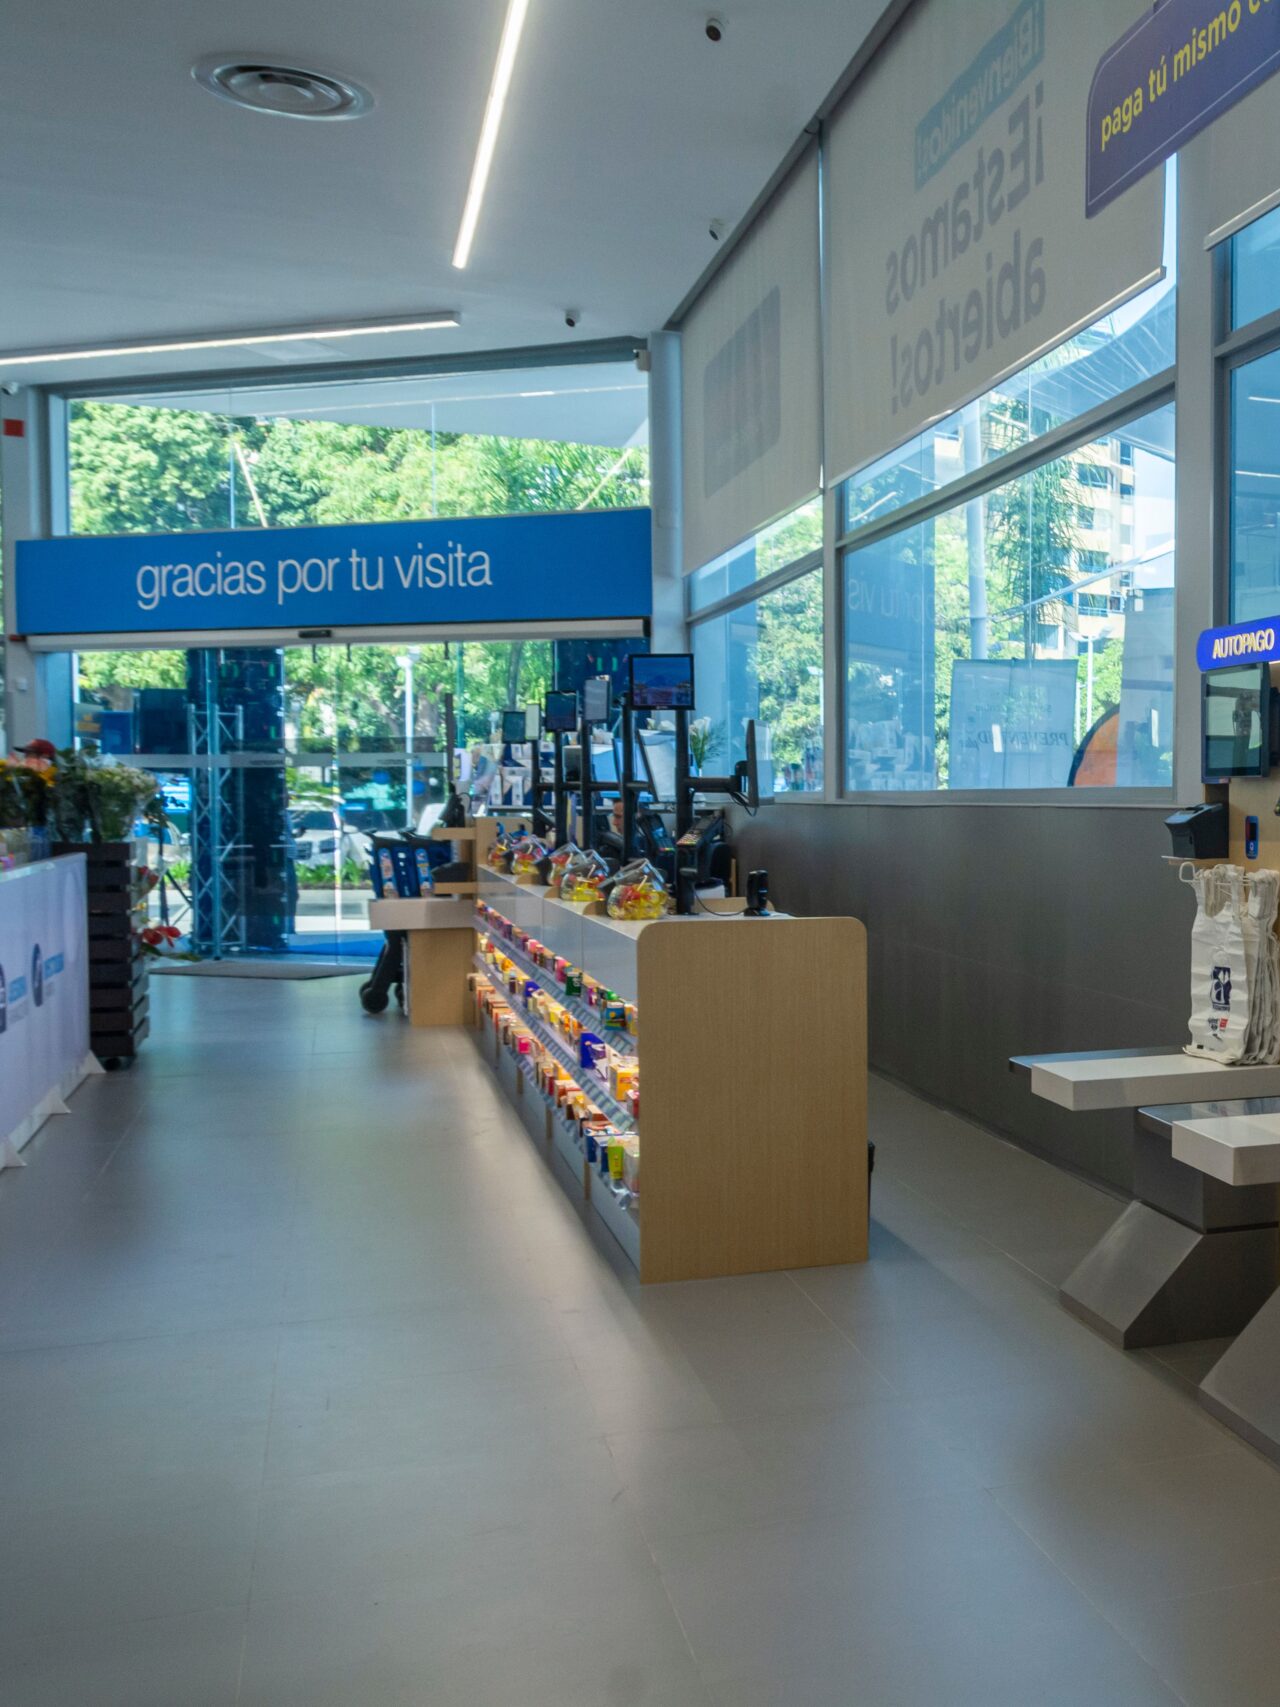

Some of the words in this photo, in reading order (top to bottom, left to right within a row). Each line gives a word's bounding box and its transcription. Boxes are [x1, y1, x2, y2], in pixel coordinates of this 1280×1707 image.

[1100, 85, 1143, 152] paga
[1148, 54, 1168, 103] tú
[1173, 0, 1241, 82] mismo
[135, 550, 267, 610] gracias
[277, 554, 341, 604] por
[348, 548, 385, 591] tu
[394, 541, 493, 589] visita
[1212, 628, 1275, 660] AUTOPAGO
